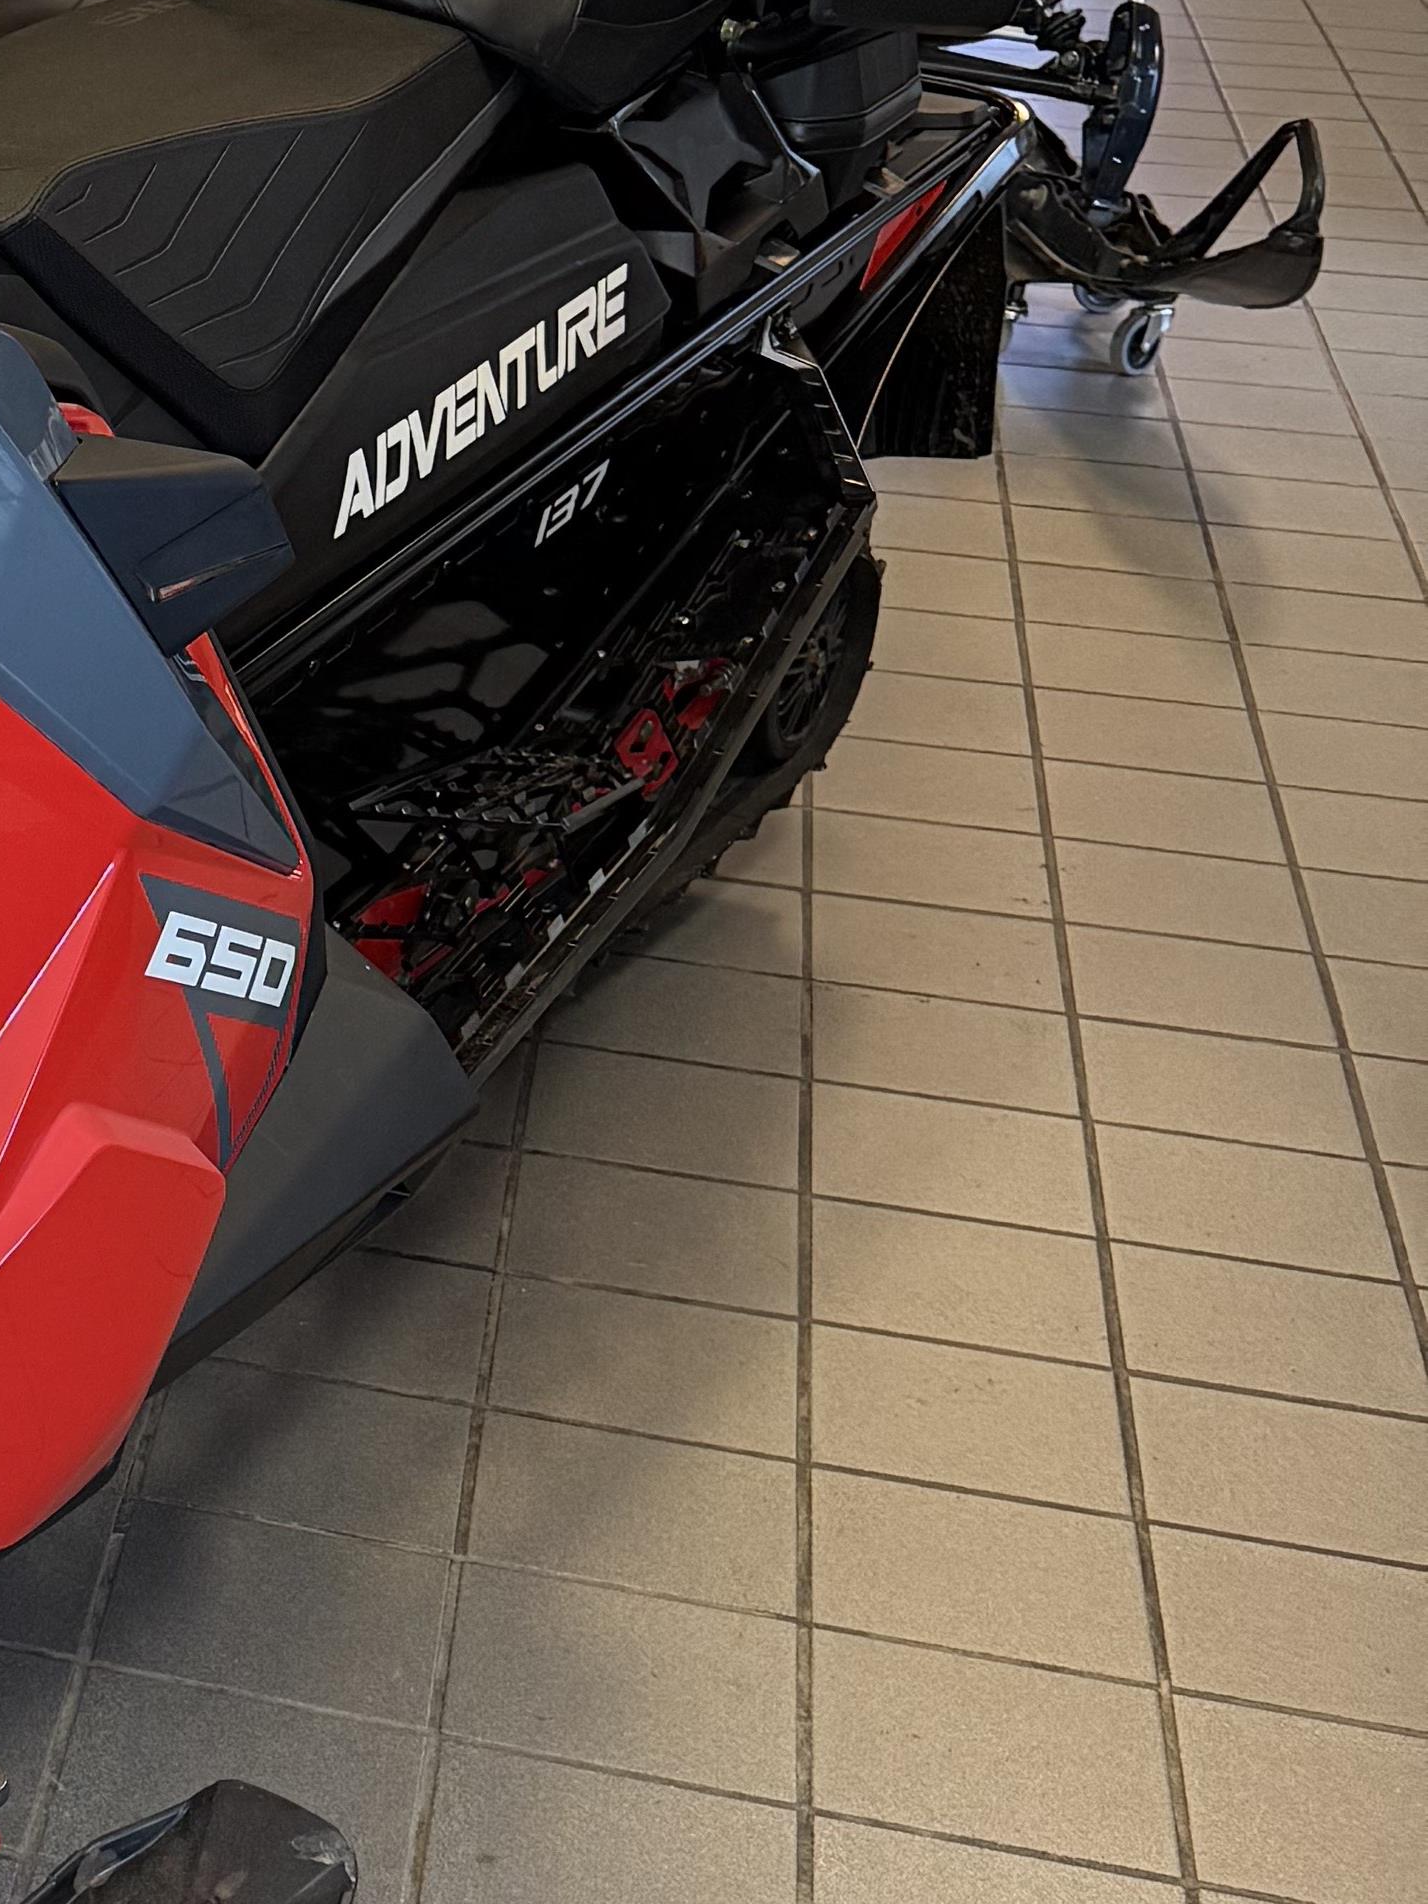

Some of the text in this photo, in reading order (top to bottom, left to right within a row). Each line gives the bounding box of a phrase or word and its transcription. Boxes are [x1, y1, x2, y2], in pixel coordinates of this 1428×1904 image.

[333, 262, 629, 539] ADVENTURE
[533, 459, 612, 549] 137
[144, 909, 298, 1009] 650
